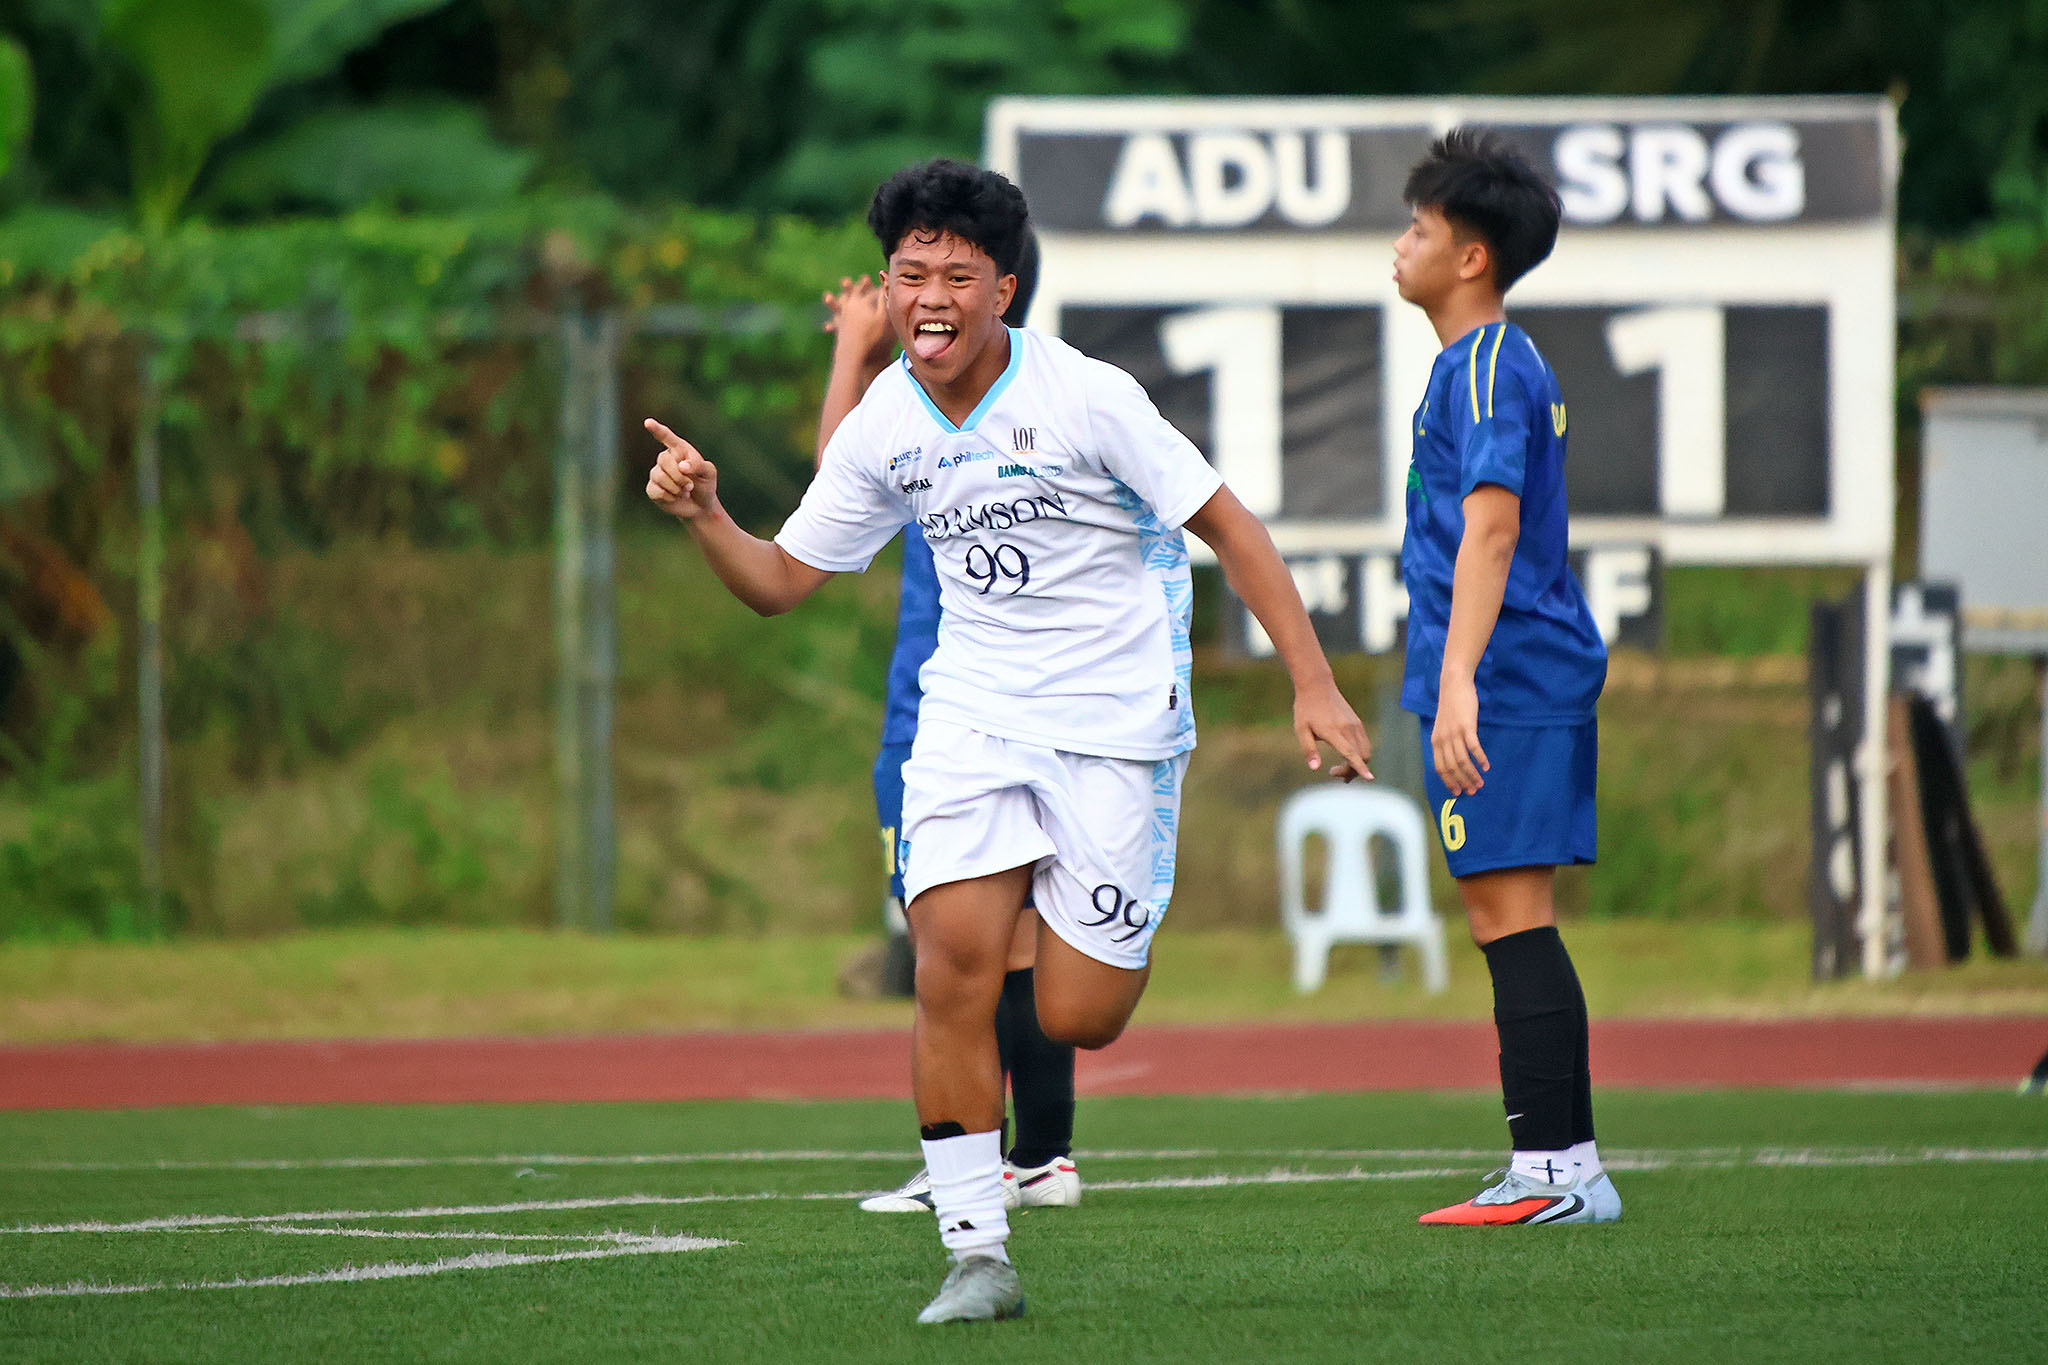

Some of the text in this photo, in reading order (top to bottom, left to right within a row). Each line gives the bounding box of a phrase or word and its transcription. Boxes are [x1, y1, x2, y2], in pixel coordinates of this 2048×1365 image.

[1104, 130, 1351, 227] ADU
[1554, 123, 1806, 224] SRG
[1159, 306, 1283, 520] 1
[1607, 306, 1726, 517] 1
[953, 449, 995, 468] philtech
[965, 543, 1031, 595] 99
[1440, 799, 1466, 853] 6
[1077, 884, 1149, 943] 99
